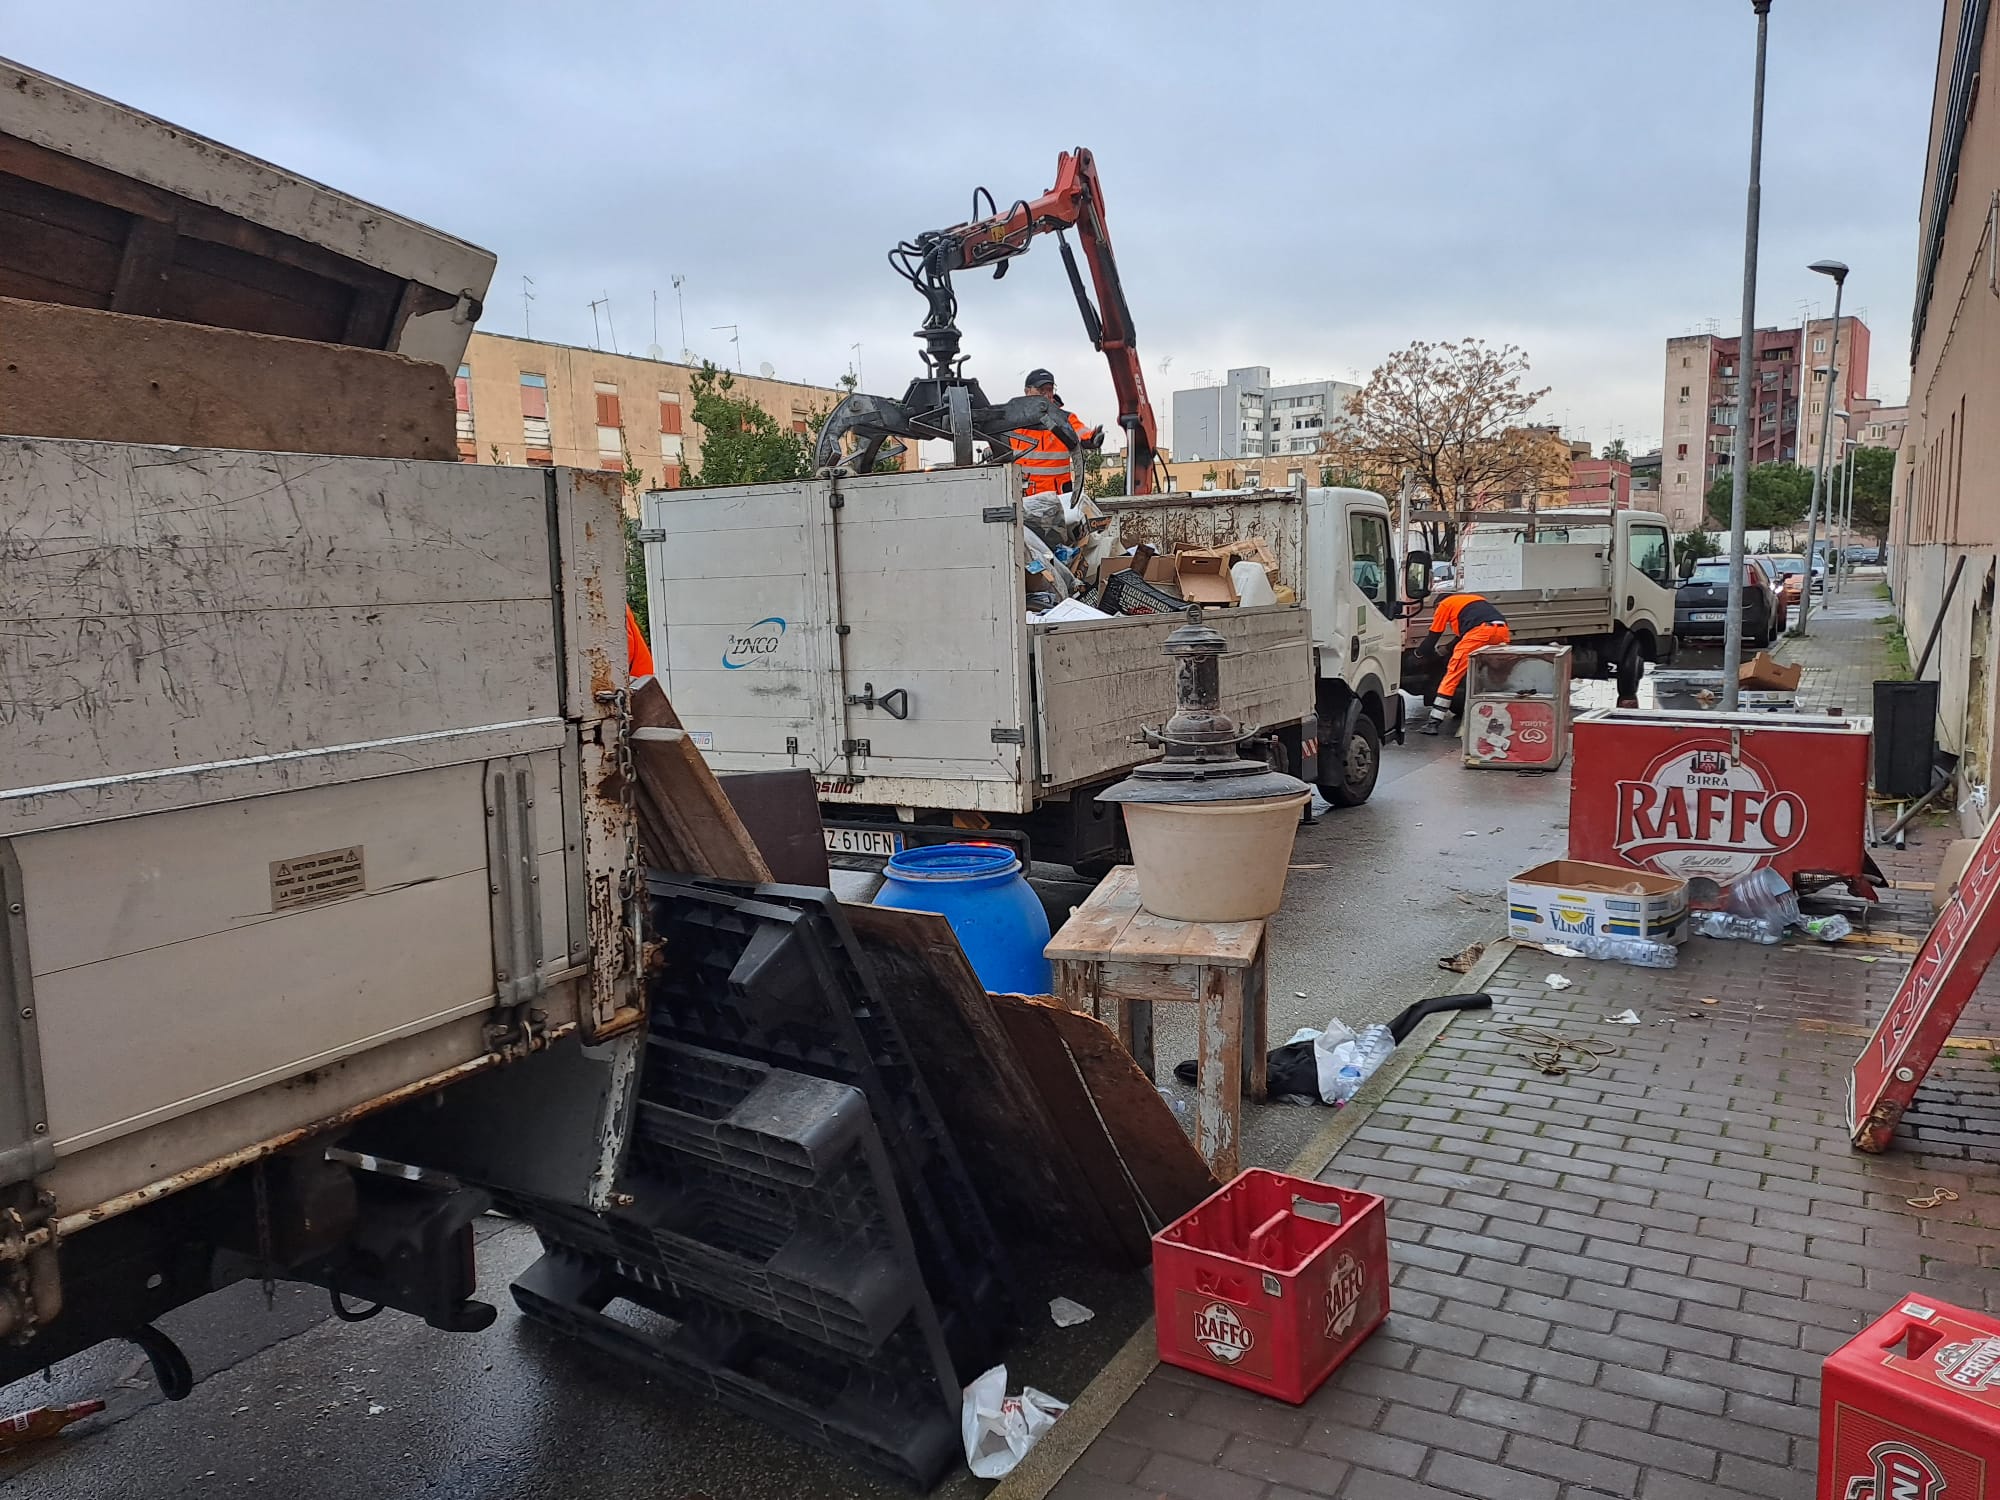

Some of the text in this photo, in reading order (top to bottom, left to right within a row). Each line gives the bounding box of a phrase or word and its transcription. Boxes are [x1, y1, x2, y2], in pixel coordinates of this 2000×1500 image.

[1687, 774, 1729, 787] BIRRA
[1616, 782, 1797, 848] RAFFO
[1549, 910, 1596, 936] BONITA
[1324, 1262, 1364, 1329] RAFFO
[1195, 1312, 1252, 1348] RAFFO
